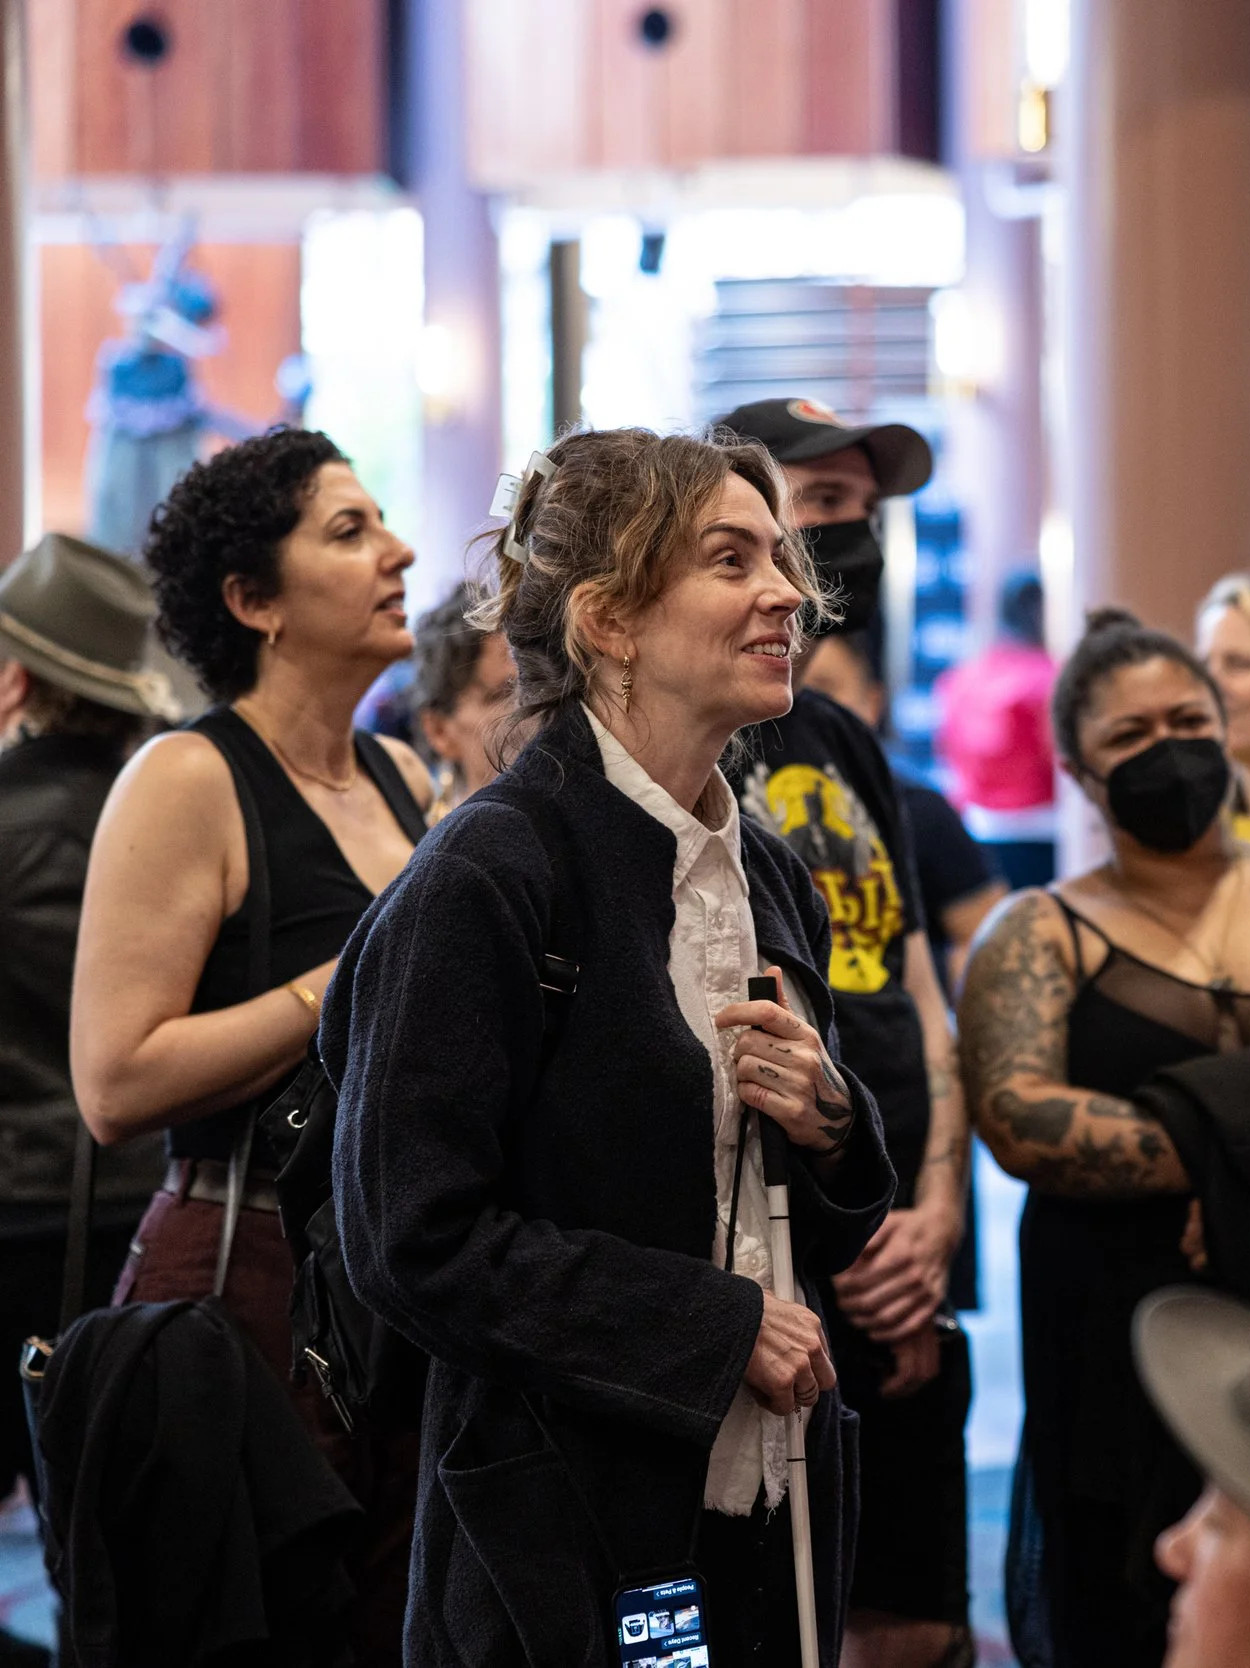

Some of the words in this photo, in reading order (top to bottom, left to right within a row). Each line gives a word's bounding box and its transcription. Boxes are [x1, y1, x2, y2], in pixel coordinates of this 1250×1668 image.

[677, 1584, 694, 1593] People
[668, 1637, 681, 1645] Days
[681, 1634, 699, 1642] Recent
